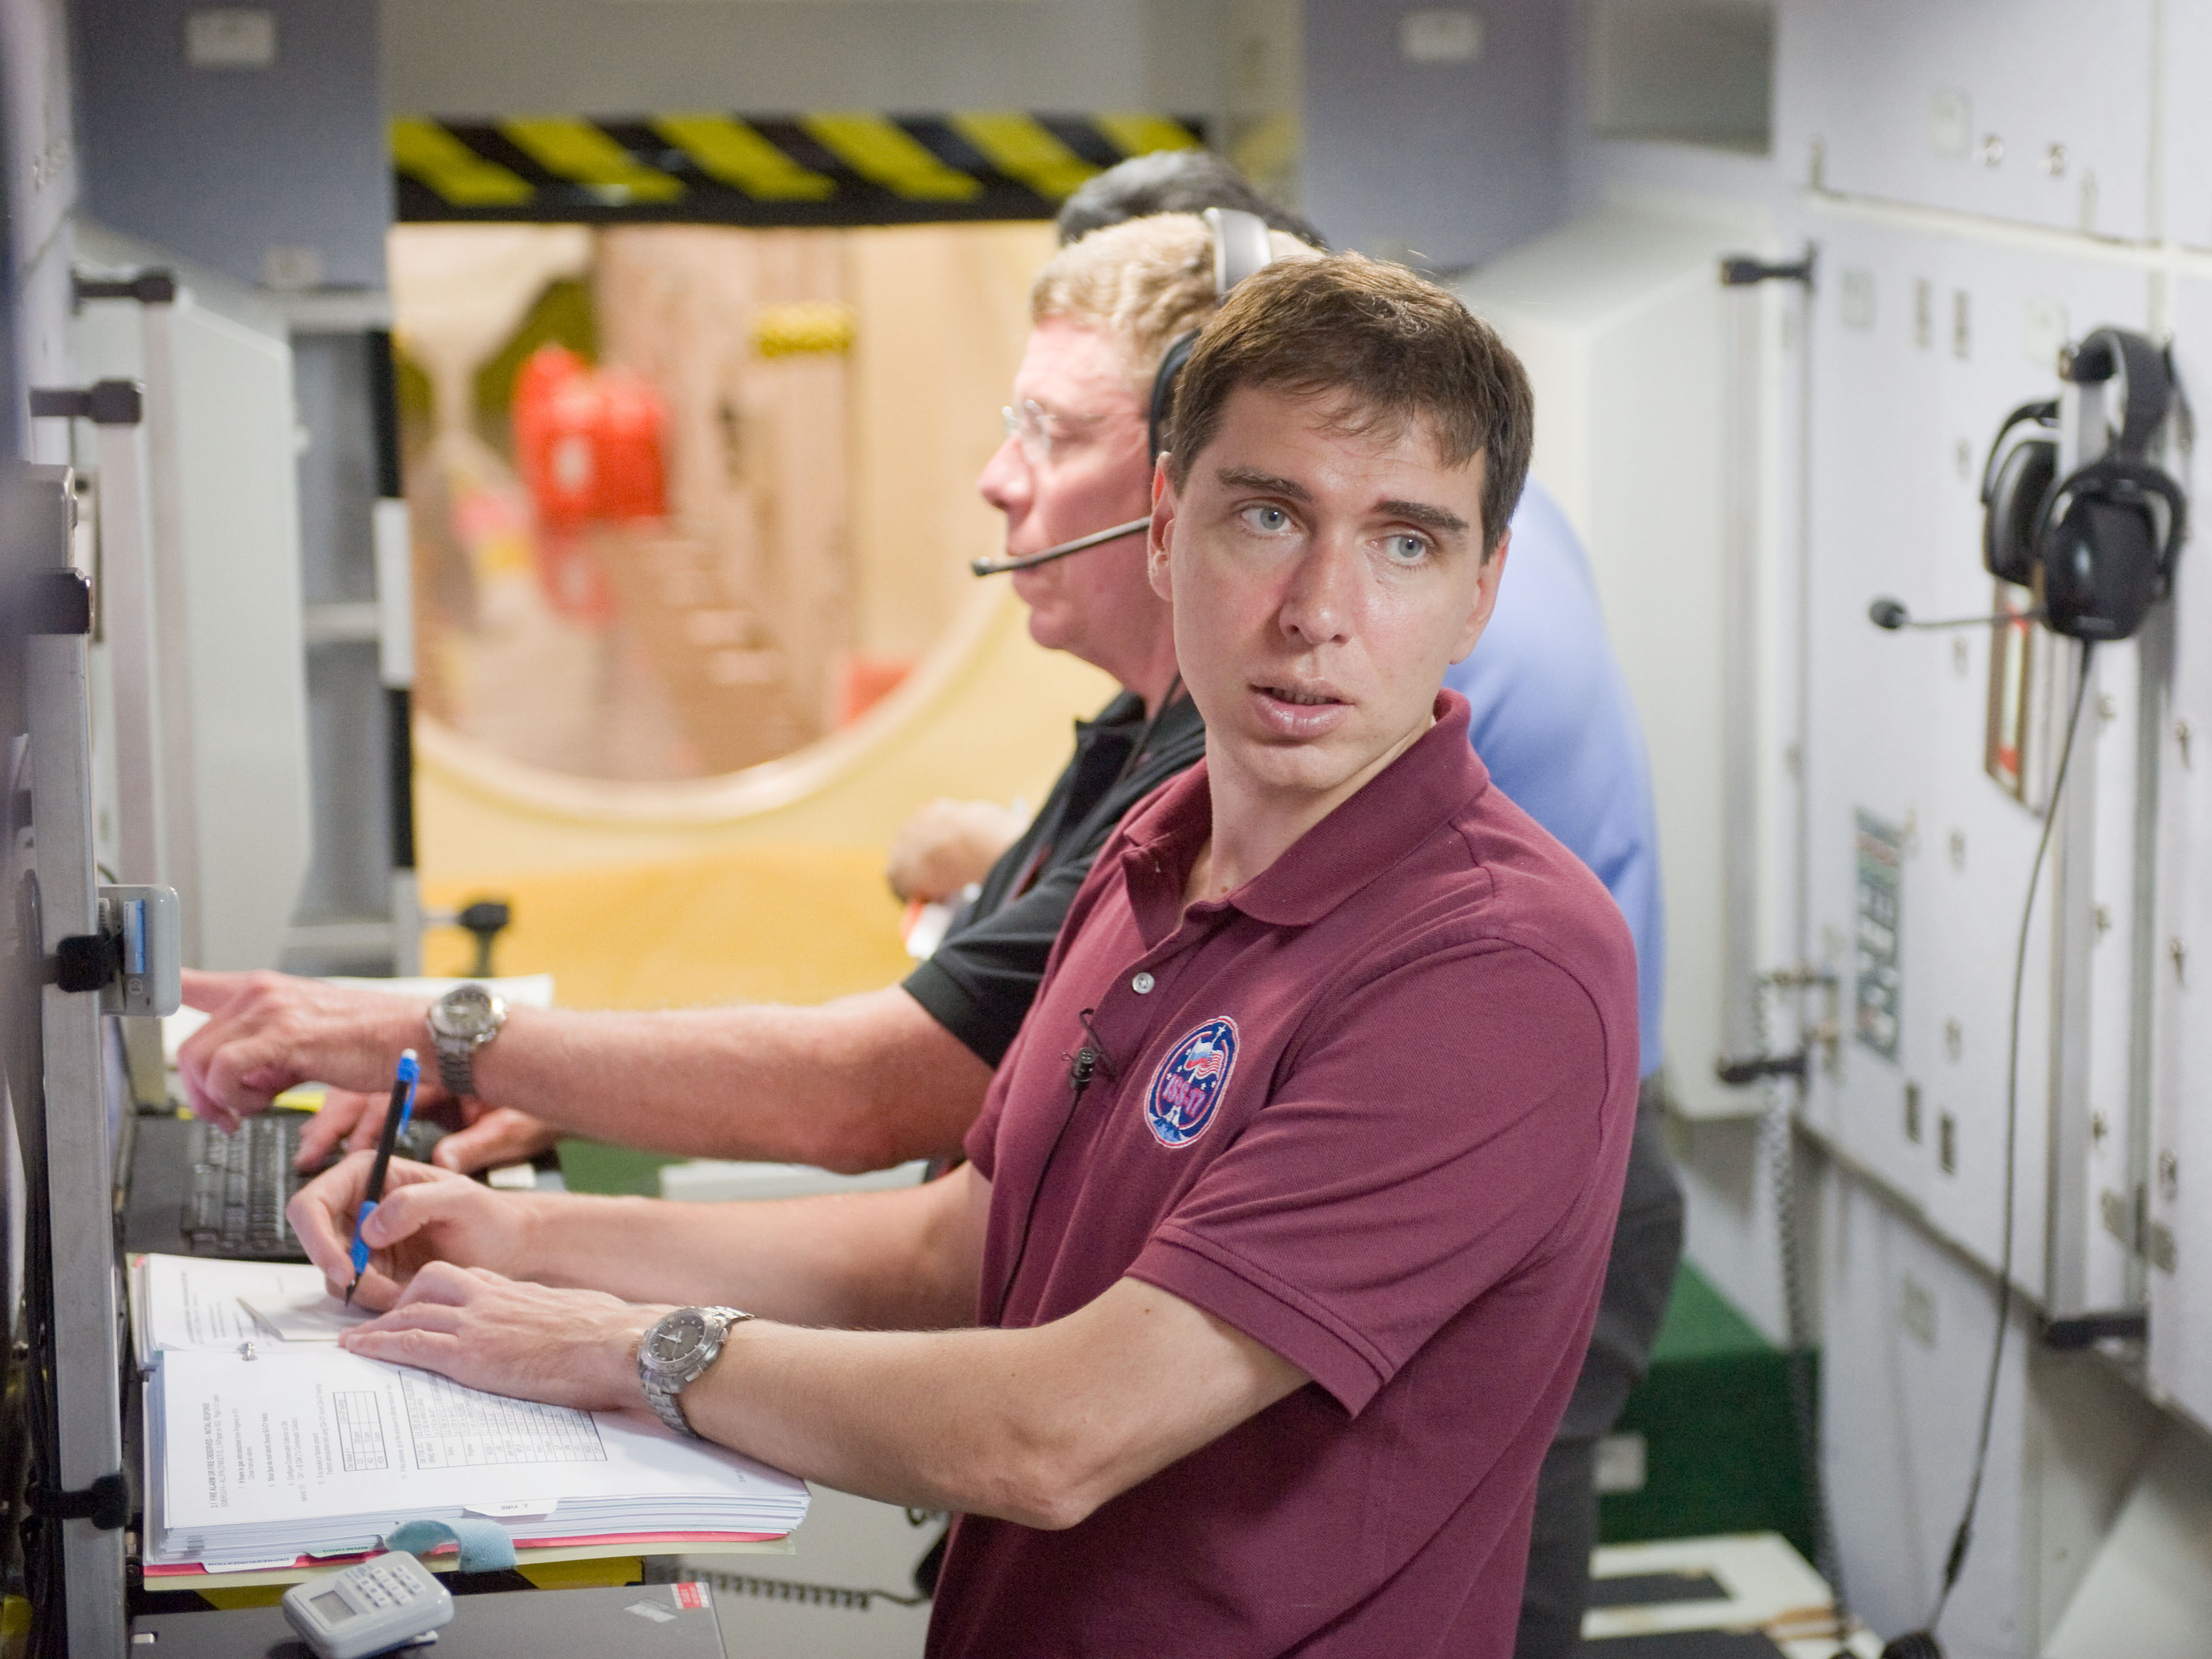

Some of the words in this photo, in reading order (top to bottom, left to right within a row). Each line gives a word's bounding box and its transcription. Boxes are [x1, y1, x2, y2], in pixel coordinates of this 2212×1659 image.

[1163, 1074, 1206, 1116] ISS-17
[202, 1402, 211, 1420] RESPONSE
[204, 1422, 212, 1434] INITIAL
[205, 1438, 214, 1460] OBSERVED
[234, 1439, 243, 1460] introduction
[208, 1477, 216, 1490] ALARM
[208, 1557, 289, 1567] DEPRESSURIZATION
